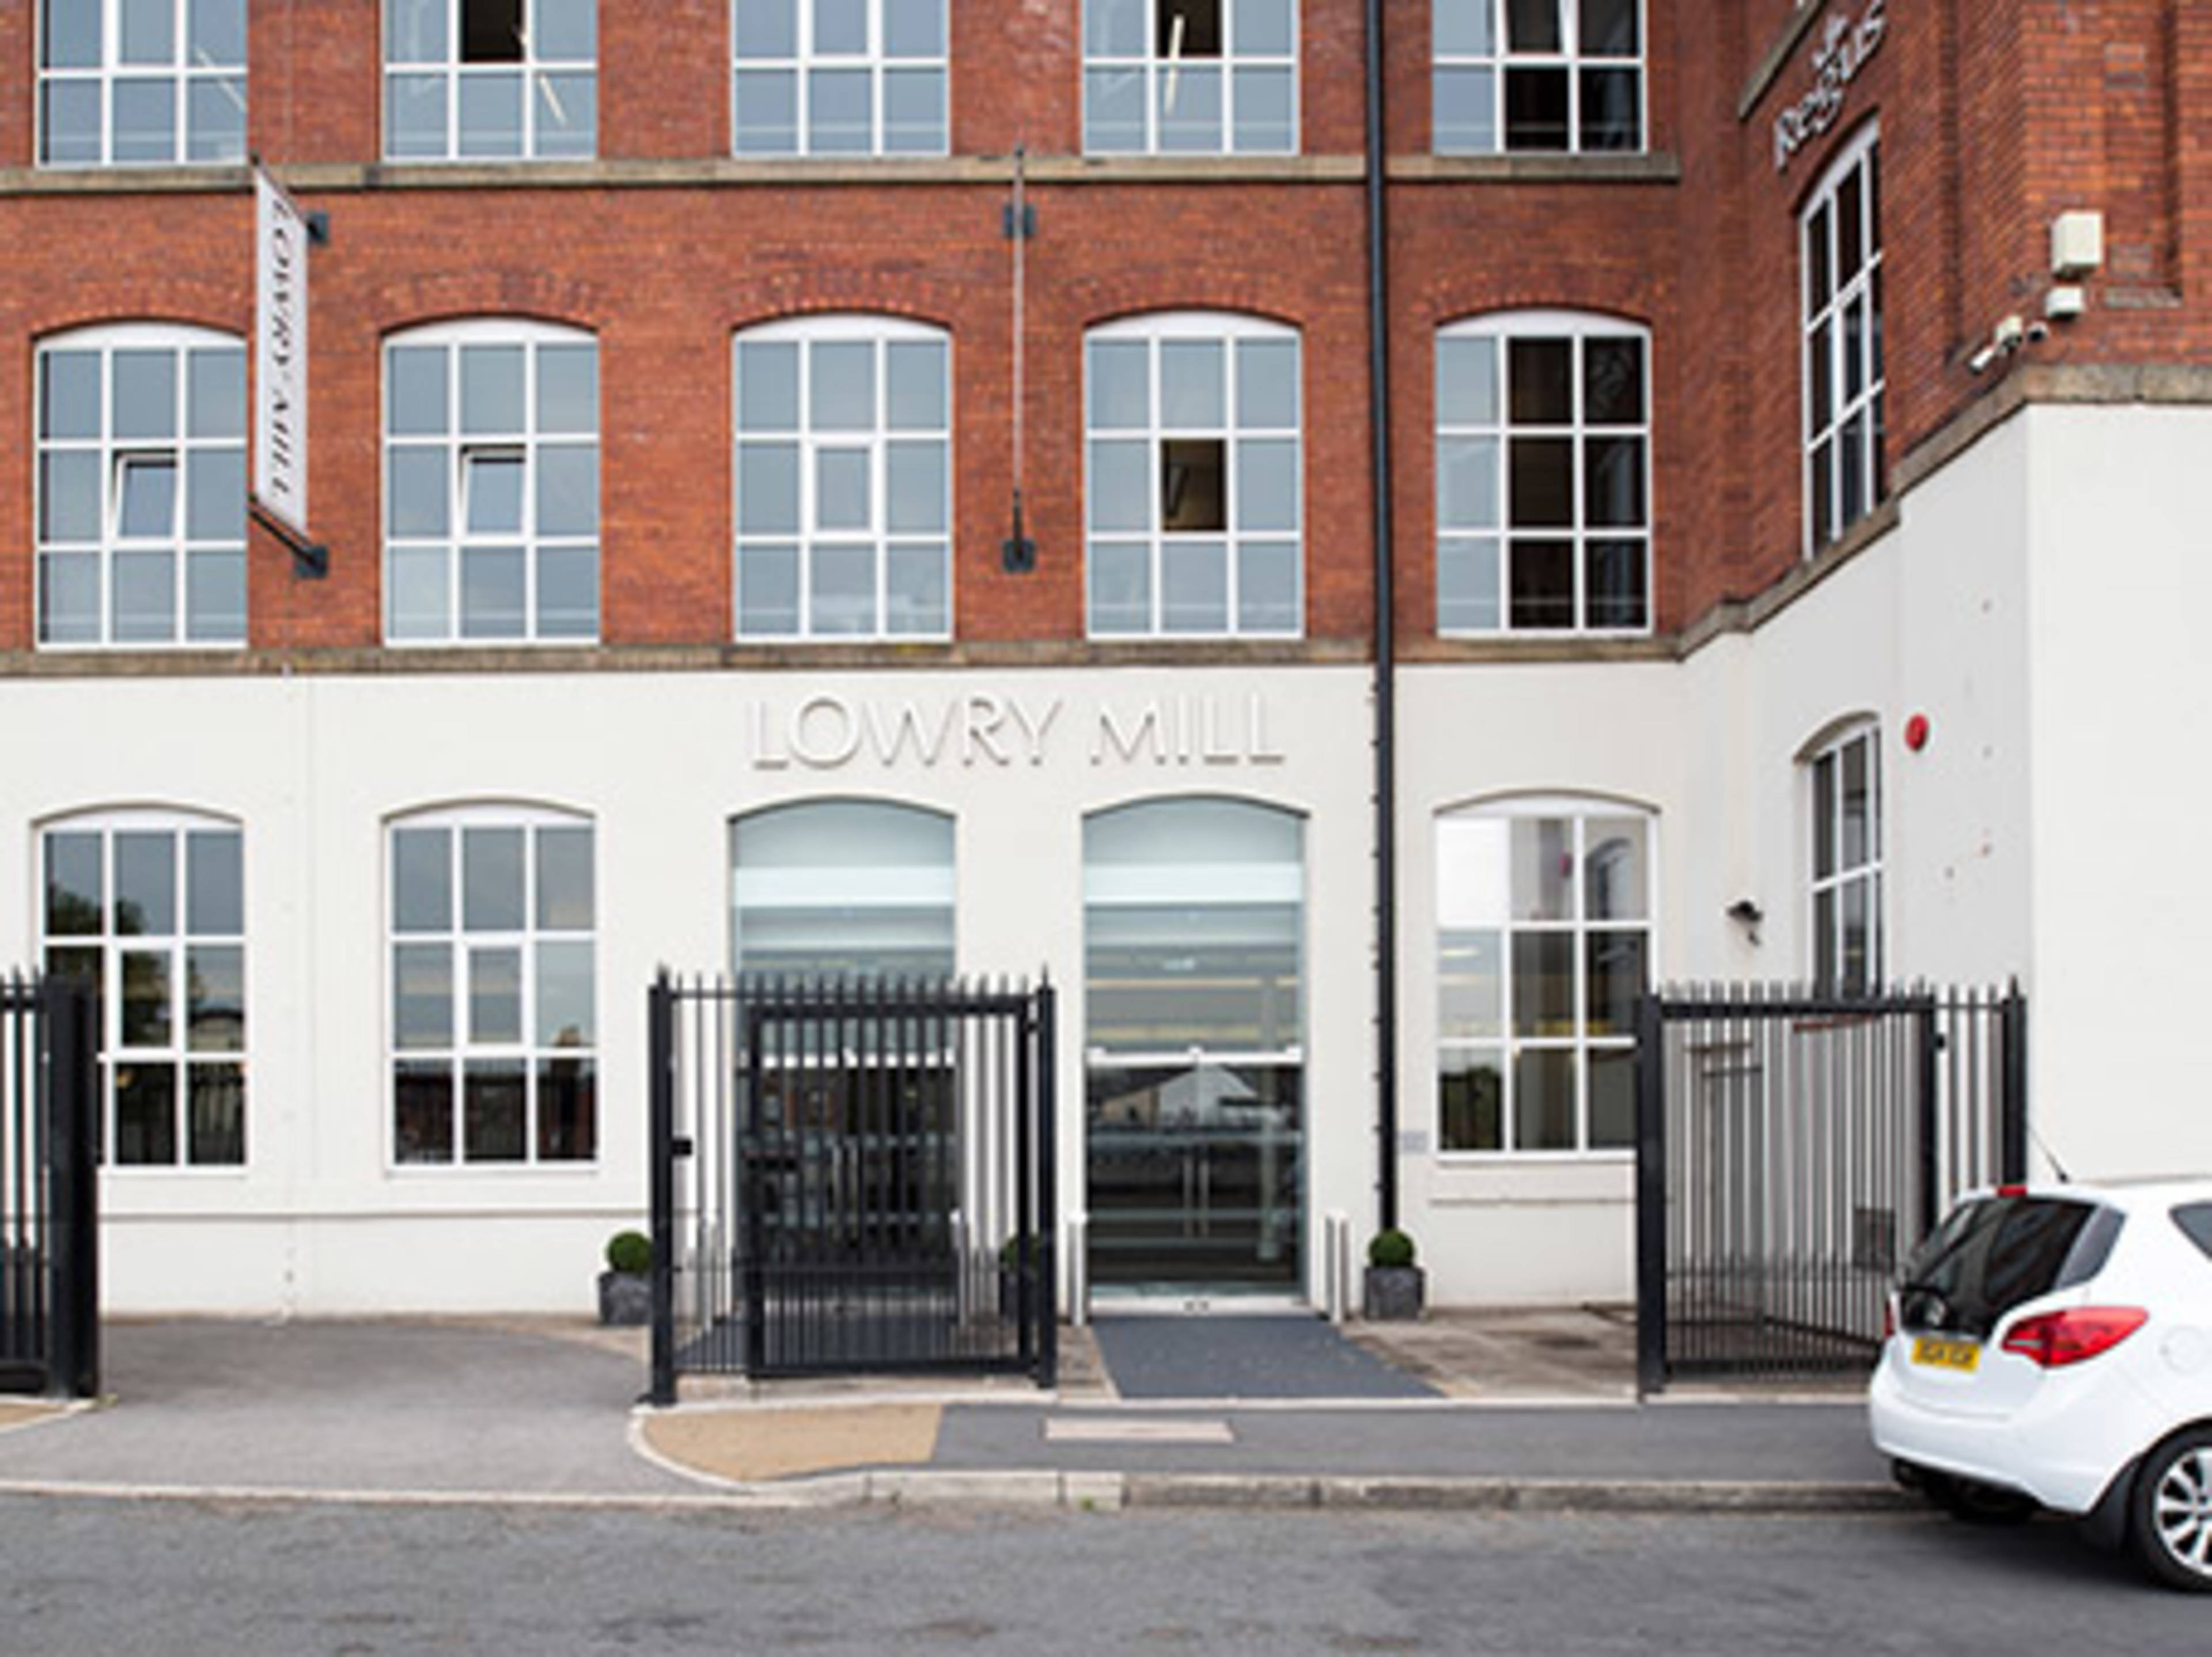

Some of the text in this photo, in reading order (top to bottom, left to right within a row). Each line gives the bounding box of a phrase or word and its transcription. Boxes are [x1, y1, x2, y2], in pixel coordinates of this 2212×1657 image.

[1773, 0, 1888, 168] Regus
[749, 691, 1286, 770] LOWRY MILL
